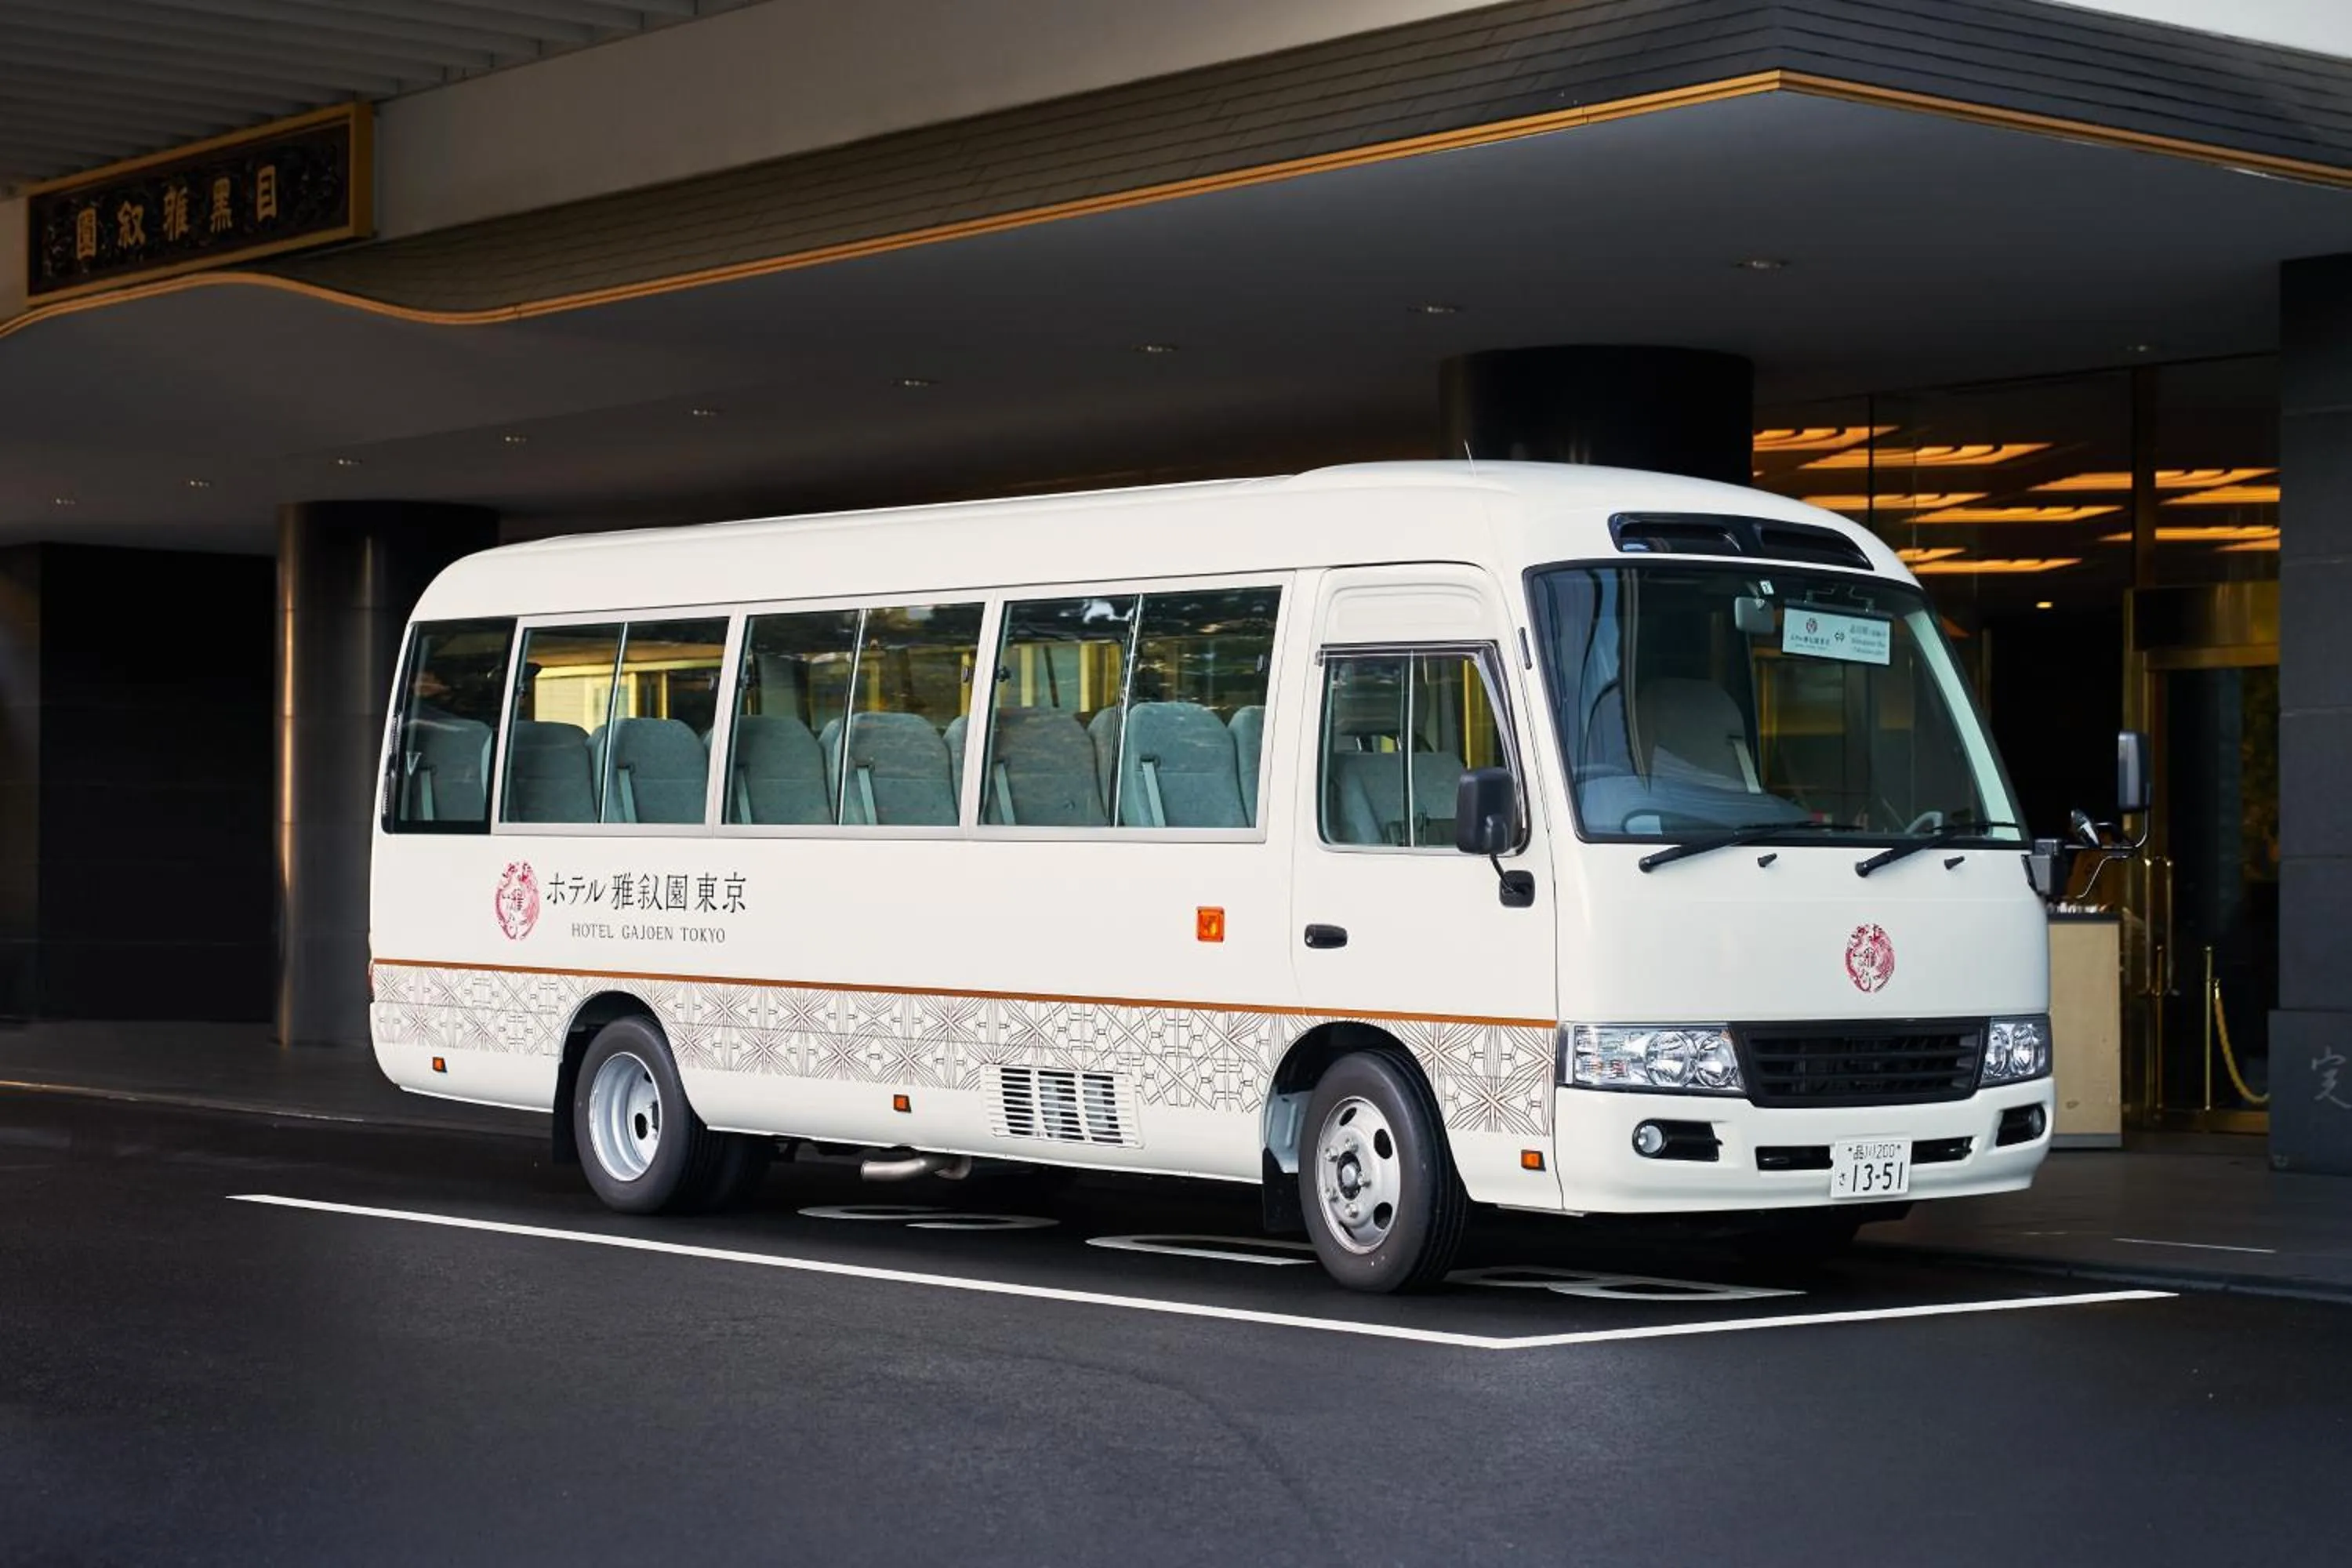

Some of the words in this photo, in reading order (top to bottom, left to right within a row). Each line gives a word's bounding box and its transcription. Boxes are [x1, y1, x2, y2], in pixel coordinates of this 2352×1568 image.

[572, 924, 614, 938] HOTEL
[622, 924, 673, 940] GAJOEN
[679, 927, 726, 942] TOKYO
